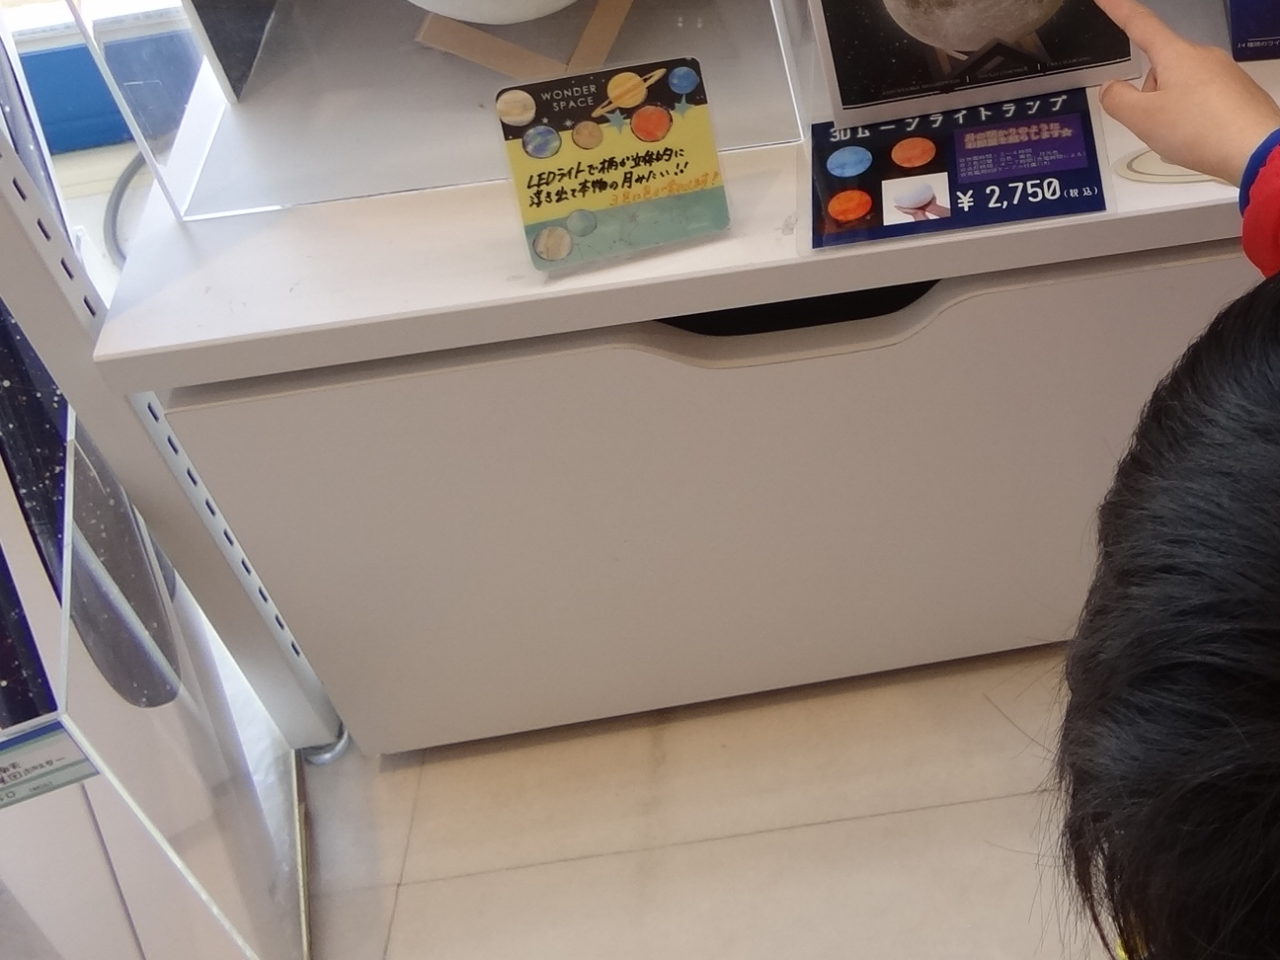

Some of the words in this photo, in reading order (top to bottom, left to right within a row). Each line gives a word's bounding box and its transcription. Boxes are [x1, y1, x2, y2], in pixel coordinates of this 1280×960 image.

[540, 84, 598, 101] WONDER
[552, 96, 595, 112] SPACE
[957, 190, 974, 212] ¥
[985, 178, 1061, 209] 2,750
